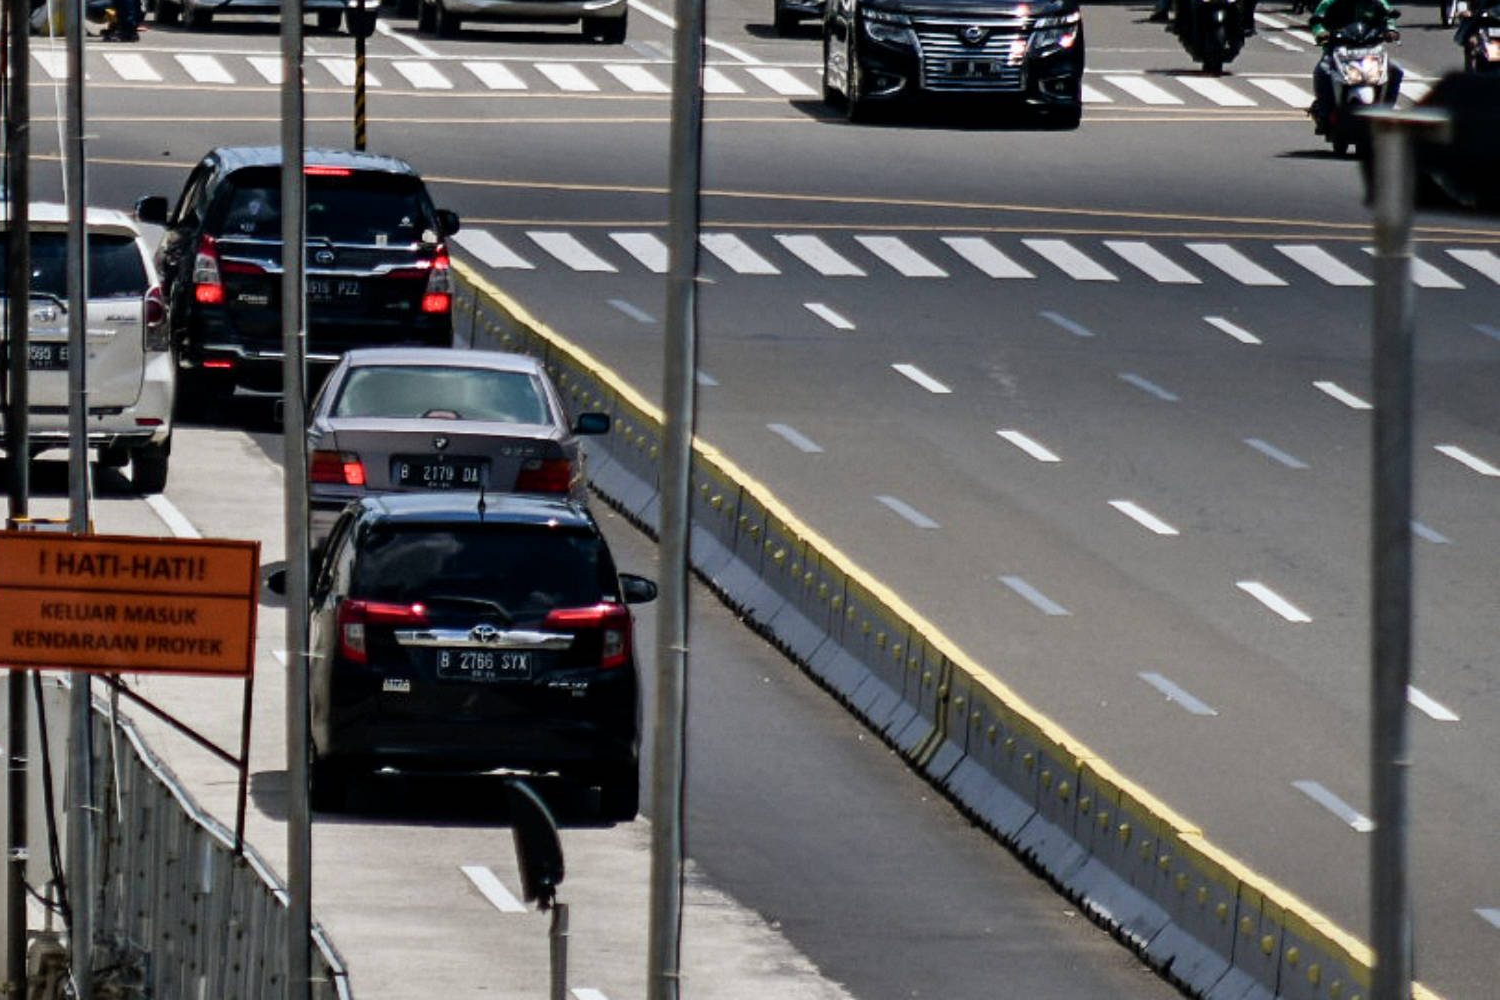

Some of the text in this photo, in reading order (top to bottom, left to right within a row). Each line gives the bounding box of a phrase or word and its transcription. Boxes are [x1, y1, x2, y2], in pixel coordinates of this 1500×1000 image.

[401, 463, 409, 479] B
[56, 552, 205, 581] HATI-HATI!
[41, 602, 197, 626] KELUAR MASUK
[13, 629, 223, 656] KENDARAAN PROYEK
[441, 651, 450, 668] B
[501, 654, 528, 670] SYX
